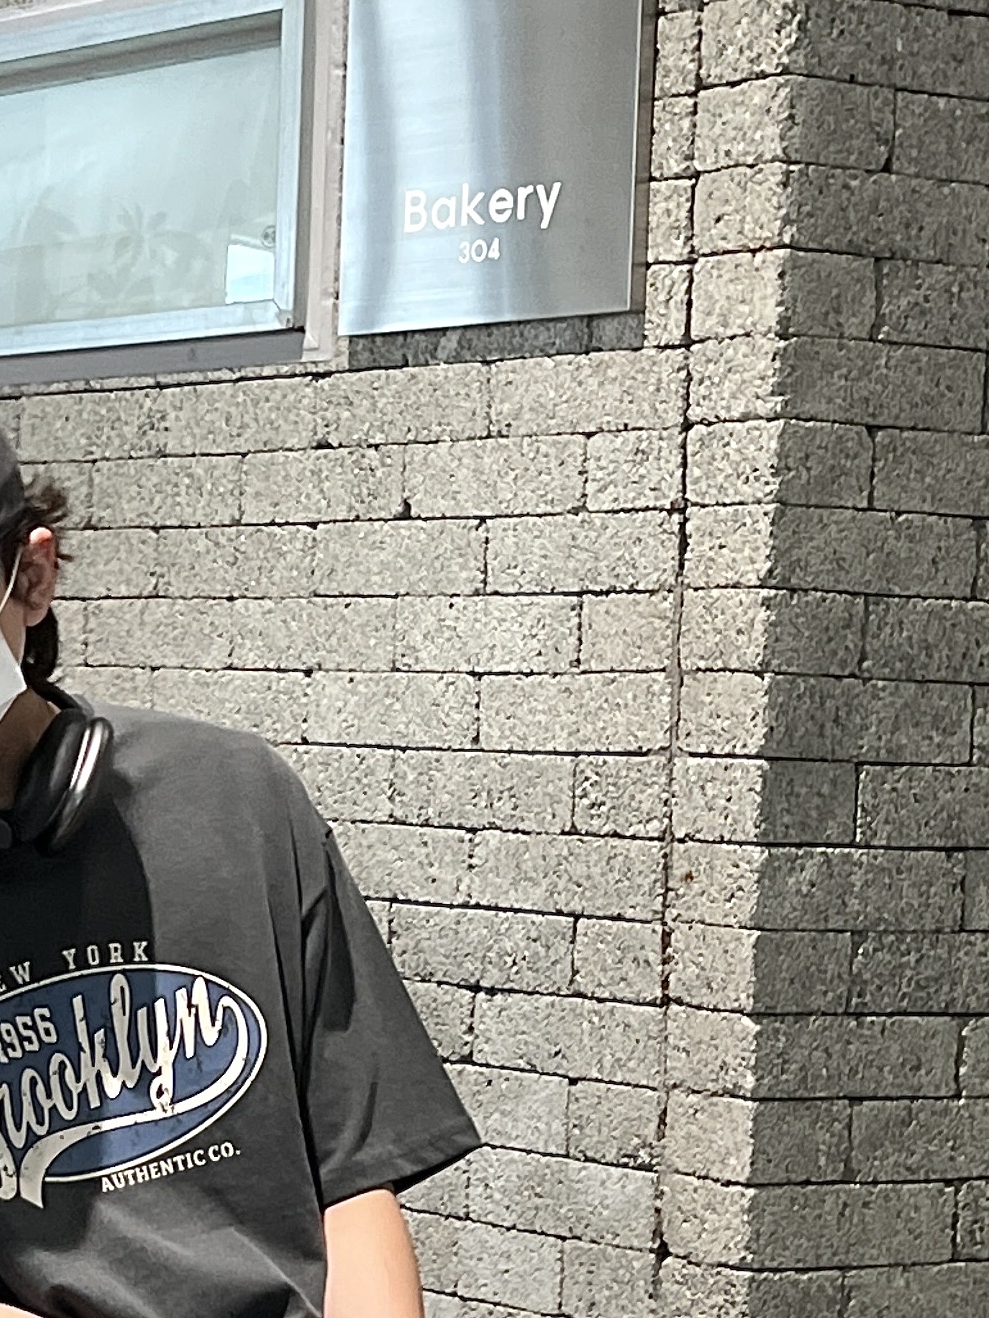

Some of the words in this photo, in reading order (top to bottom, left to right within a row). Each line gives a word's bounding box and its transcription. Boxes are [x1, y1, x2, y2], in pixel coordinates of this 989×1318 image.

[403, 181, 562, 233] Bakery
[458, 237, 501, 264] 304
[62, 941, 149, 970] YORK
[101, 1149, 206, 1193] AUTHENTIC
[208, 1141, 241, 1162] CO.
